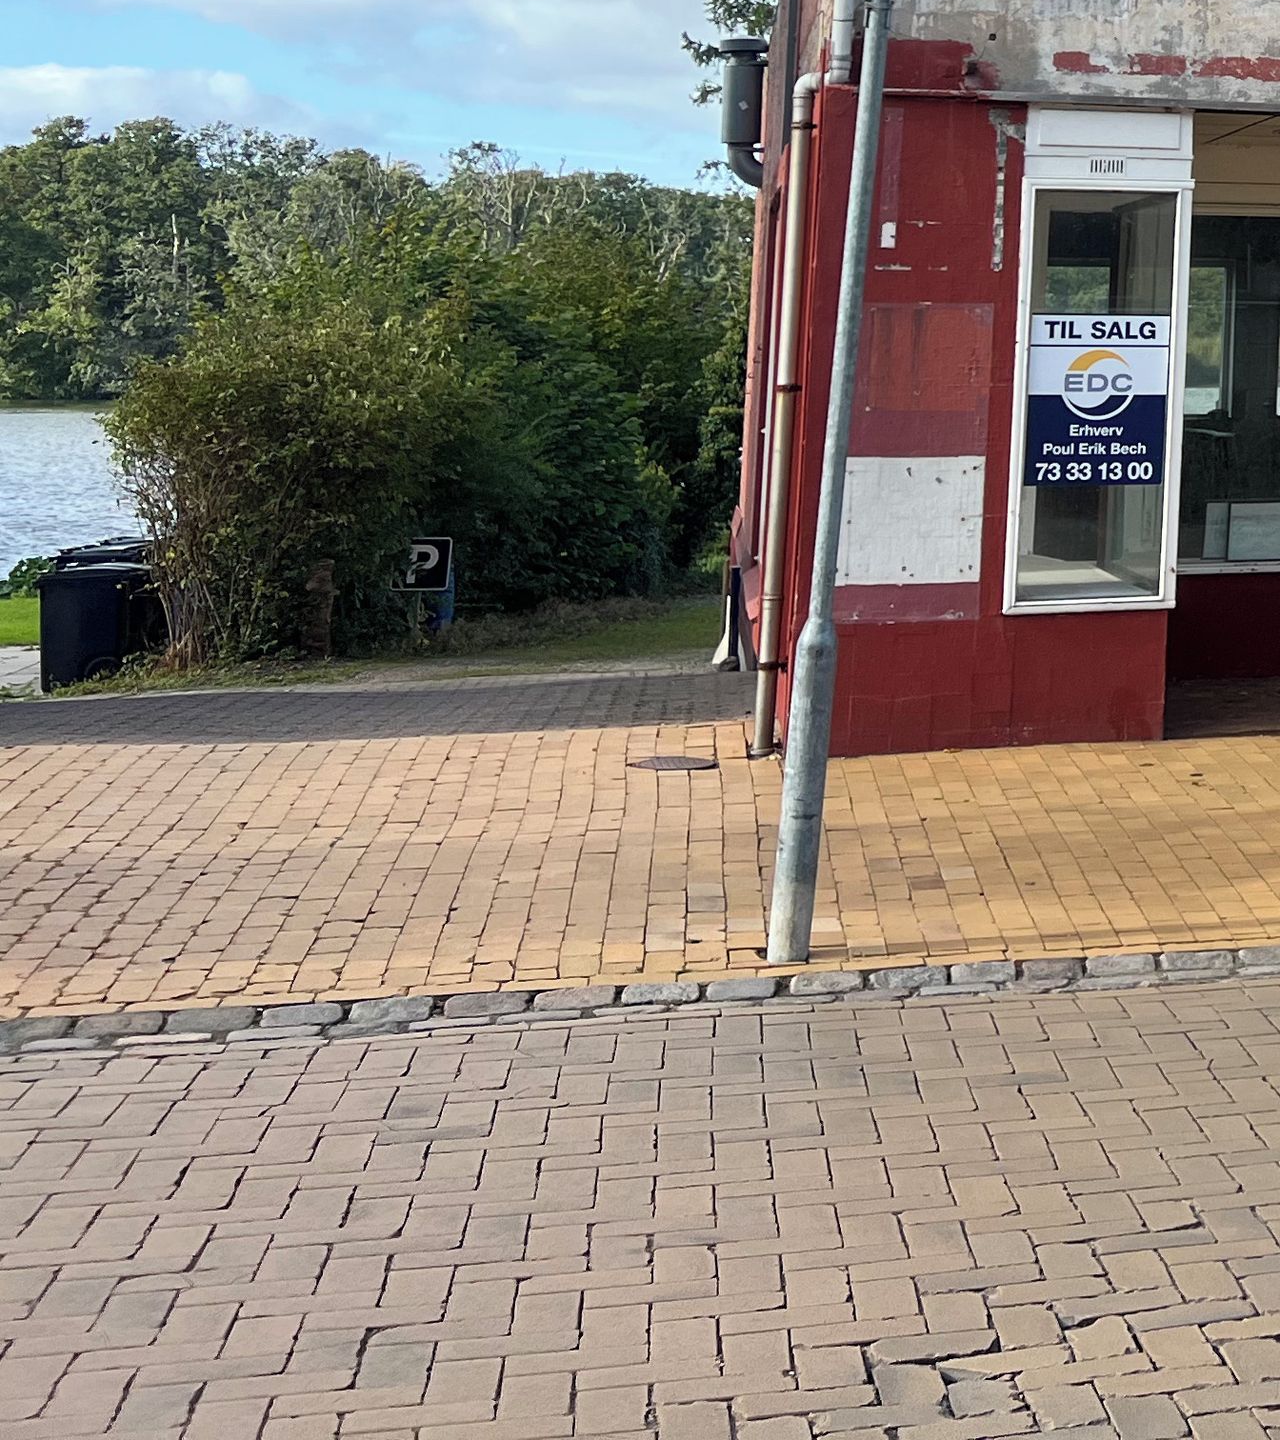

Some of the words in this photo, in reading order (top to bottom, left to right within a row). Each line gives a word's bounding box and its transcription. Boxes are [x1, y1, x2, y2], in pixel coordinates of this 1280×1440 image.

[1044, 320, 1082, 339] TIL
[1090, 321, 1157, 340] SALG
[1063, 373, 1133, 393] EDC
[1069, 424, 1124, 437] Erhverv
[1042, 443, 1075, 455] Poul
[1078, 443, 1107, 455] Erik
[1110, 443, 1147, 455] Bech
[1035, 462, 1061, 481] 73
[1065, 462, 1092, 481] 33
[1097, 462, 1123, 480] 13
[1127, 461, 1153, 480] 00
[405, 544, 439, 584] P
